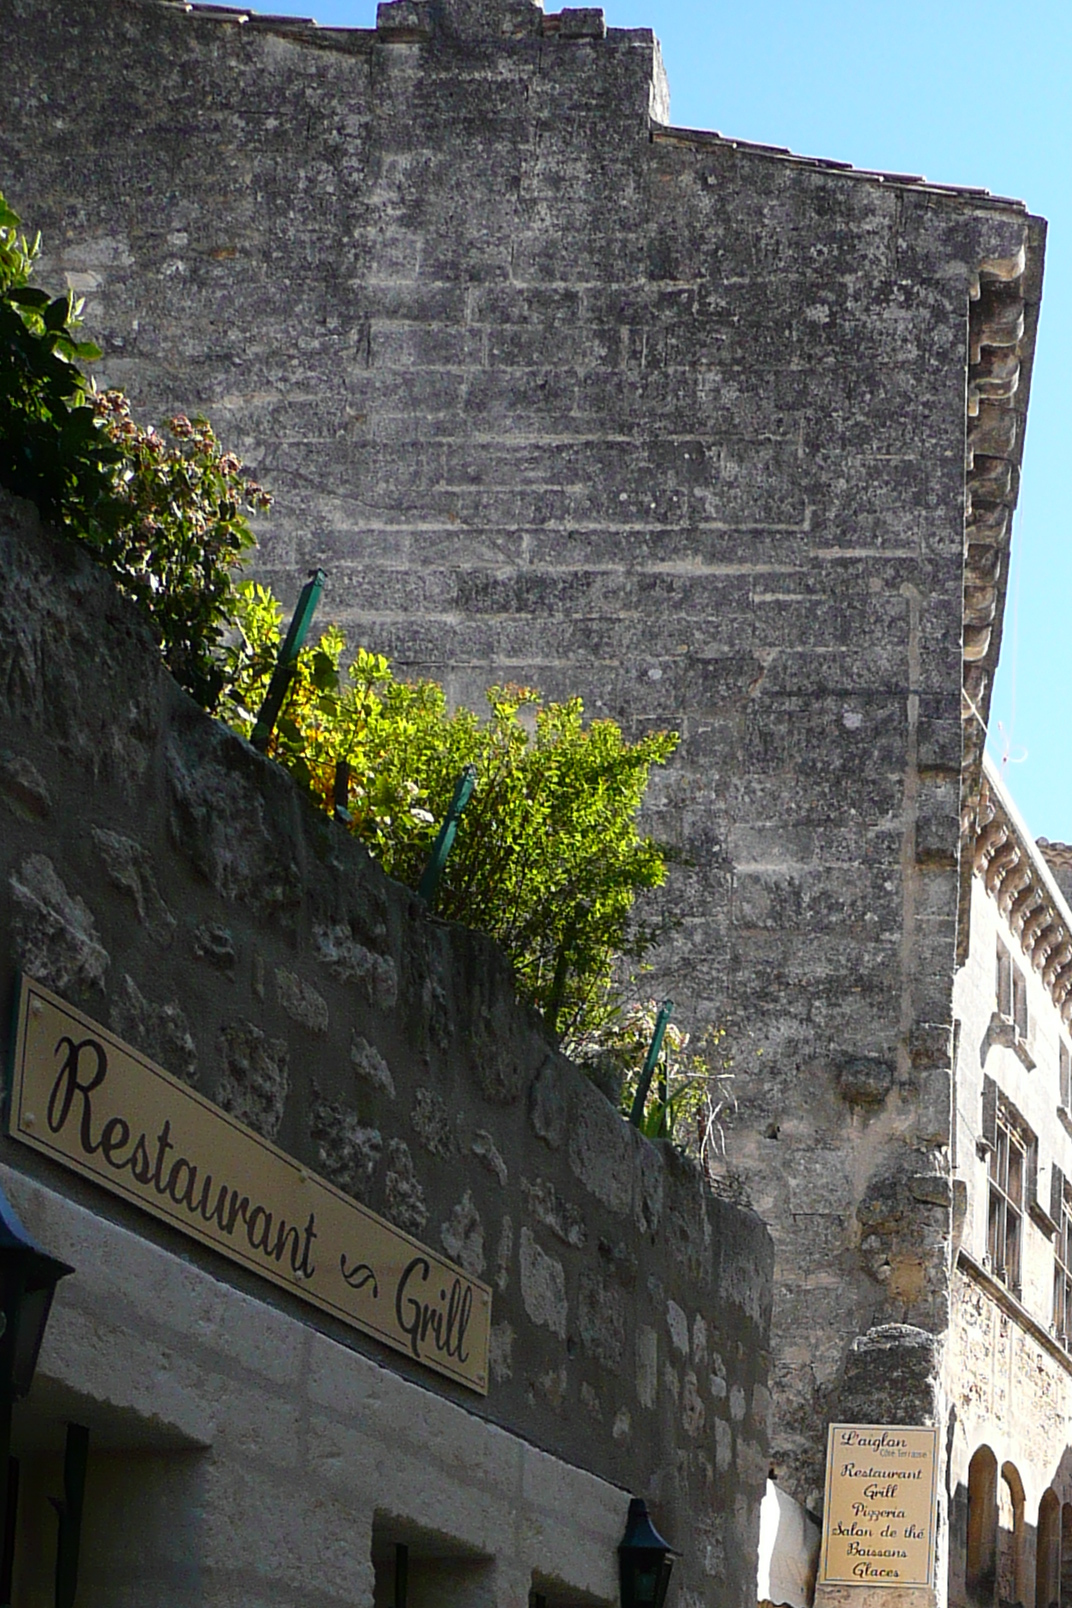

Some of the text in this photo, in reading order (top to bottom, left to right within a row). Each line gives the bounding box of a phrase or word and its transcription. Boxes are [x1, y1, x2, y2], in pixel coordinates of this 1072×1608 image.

[47, 1035, 472, 1363] Restaurant Grill
[840, 1463, 923, 1480] Restaurant
[863, 1483, 898, 1501] Grill
[852, 1502, 906, 1522] Pizzeria
[832, 1521, 926, 1540] Salon de thé
[847, 1541, 908, 1559] Boissons
[852, 1561, 900, 1578] Glaces
